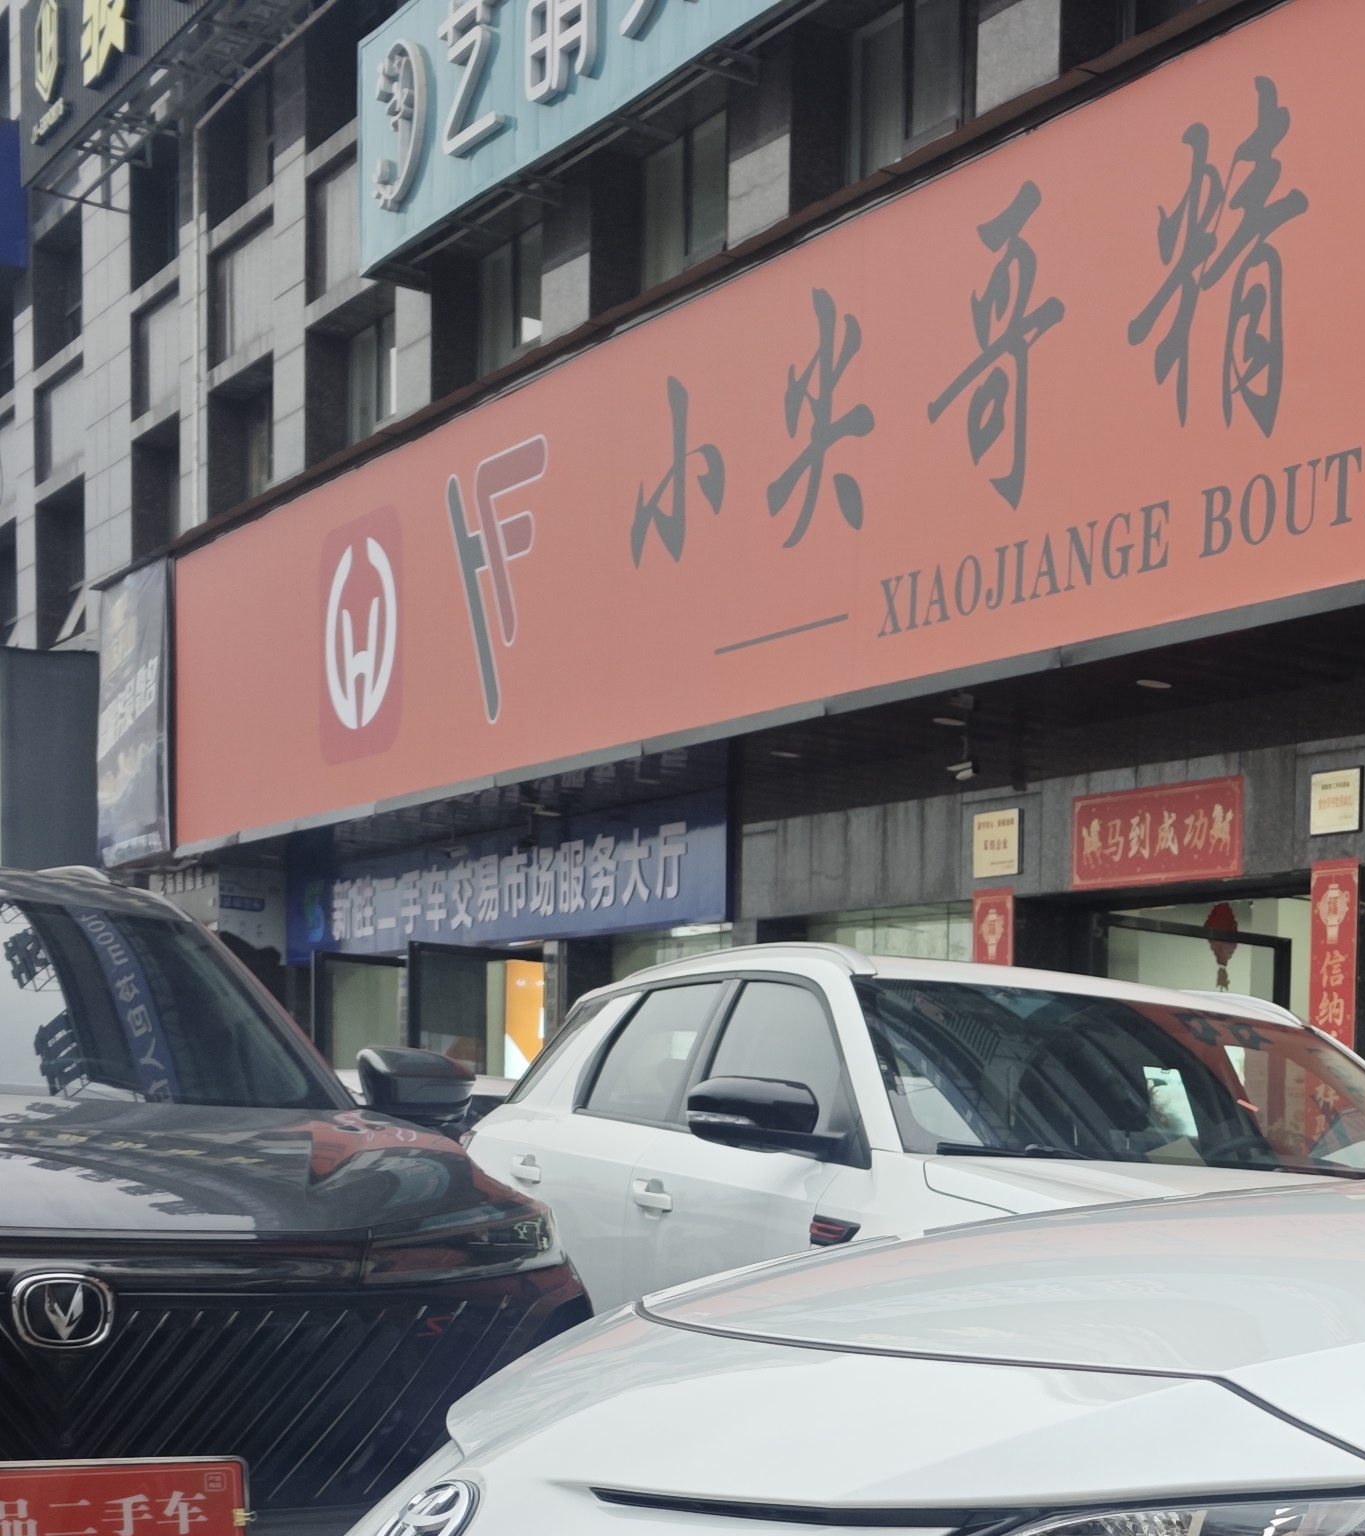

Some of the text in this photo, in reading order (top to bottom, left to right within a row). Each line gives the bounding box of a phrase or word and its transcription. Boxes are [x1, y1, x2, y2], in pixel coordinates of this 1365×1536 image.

[438, 0, 704, 156] 艺明
[877, 500, 1170, 639] XIAOJIANGE
[332, 821, 688, 941] 新胜二手车交易市场服务大厅
[1104, 808, 1209, 862] 马到成功
[1318, 950, 1347, 1038] 信纳
